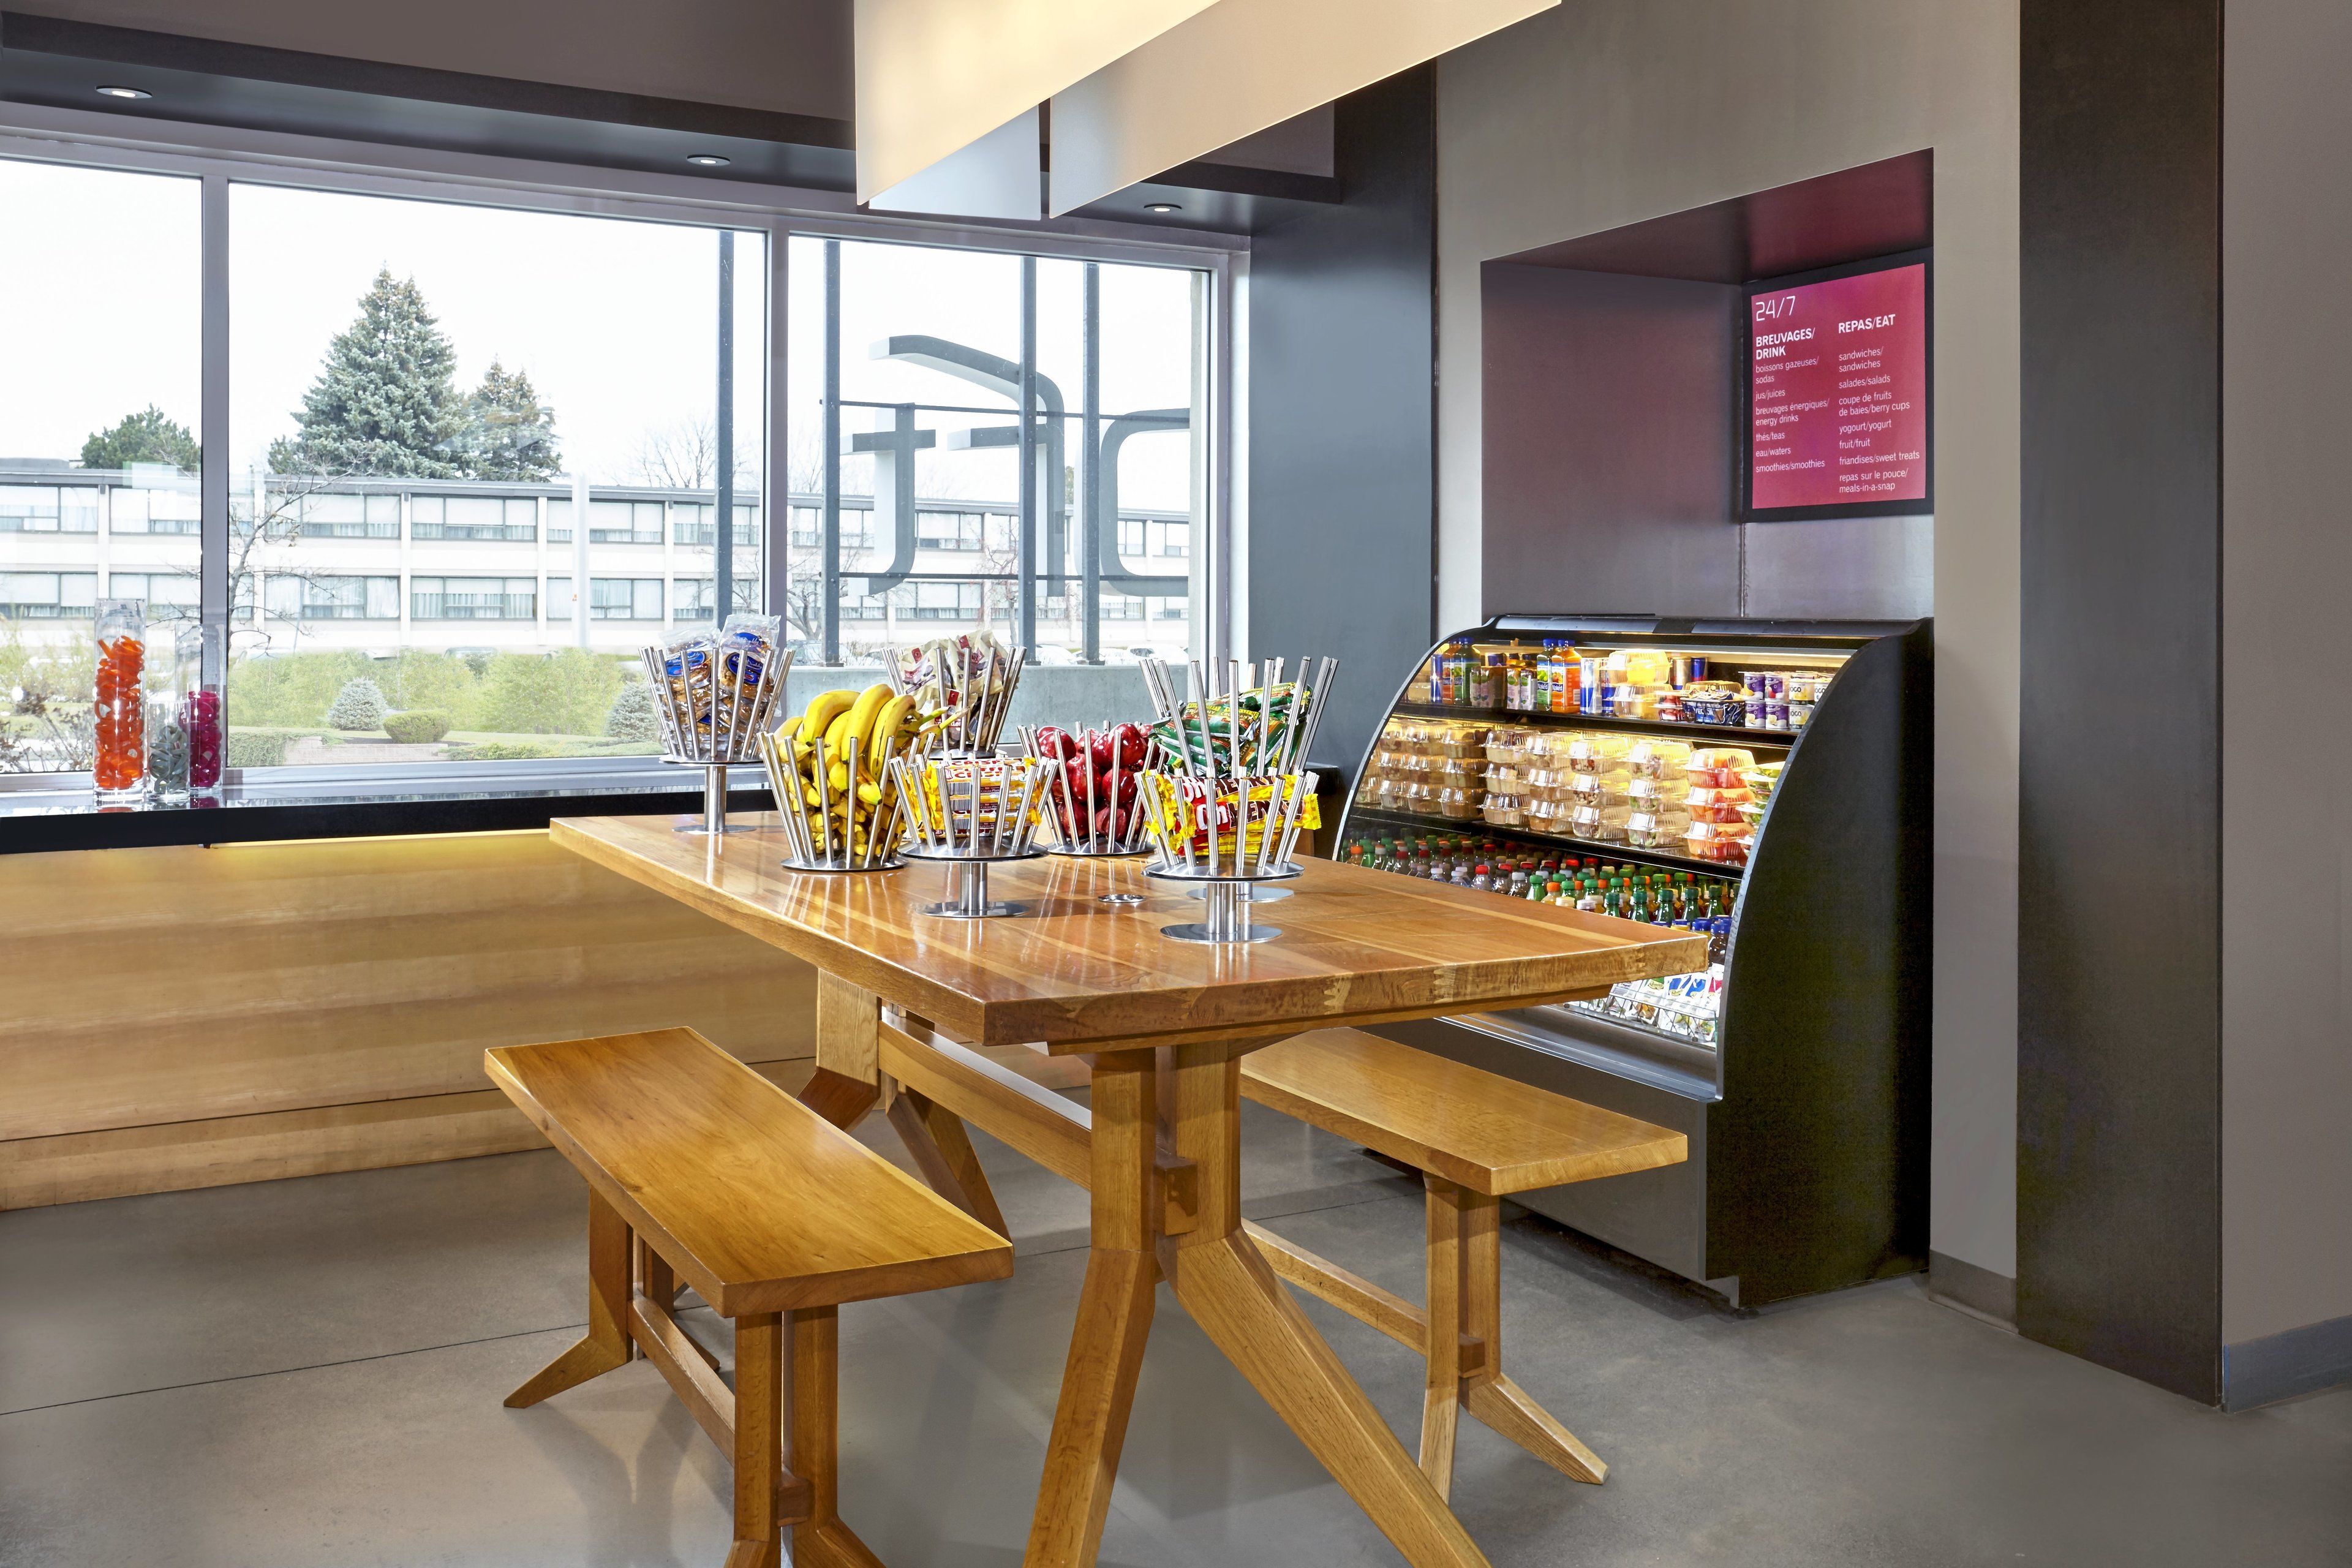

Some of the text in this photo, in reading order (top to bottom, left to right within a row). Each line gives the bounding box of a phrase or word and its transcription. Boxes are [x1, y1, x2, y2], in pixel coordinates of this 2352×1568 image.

[1755, 296, 1795, 321] 24/7
[1839, 314, 1896, 333] REPAS/EAT
[1756, 328, 1815, 347] BREUVAGES/
[1756, 345, 1786, 360] DRINK
[1839, 345, 1883, 361] sandwiches/
[1755, 356, 1819, 373] boissons gazeuses/
[1839, 360, 1880, 372] sandwiches
[1755, 375, 1774, 384] sodas
[1839, 374, 1891, 388] salades/salads
[1755, 389, 1785, 401] jus/juices
[1839, 391, 1892, 405] coupe de fruits
[1755, 398, 1830, 415] breuvages énergiques/
[1839, 402, 1910, 417] de baies/berry cups
[1755, 413, 1798, 426] energy drinks
[1839, 419, 1891, 435] yogourt/yogurt
[1756, 432, 1785, 441] thés/teas
[1839, 438, 1870, 449] fruit/fruit
[1755, 447, 1791, 457] eau/waters
[1839, 451, 1920, 465] friandises/sweet treats
[1755, 459, 1825, 473] smoothies/smoothies
[1839, 473, 1858, 483] repas
[1874, 470, 1880, 479] le
[1883, 468, 1909, 480] pouce/
[1839, 483, 1895, 493] meals-in-a-snap
